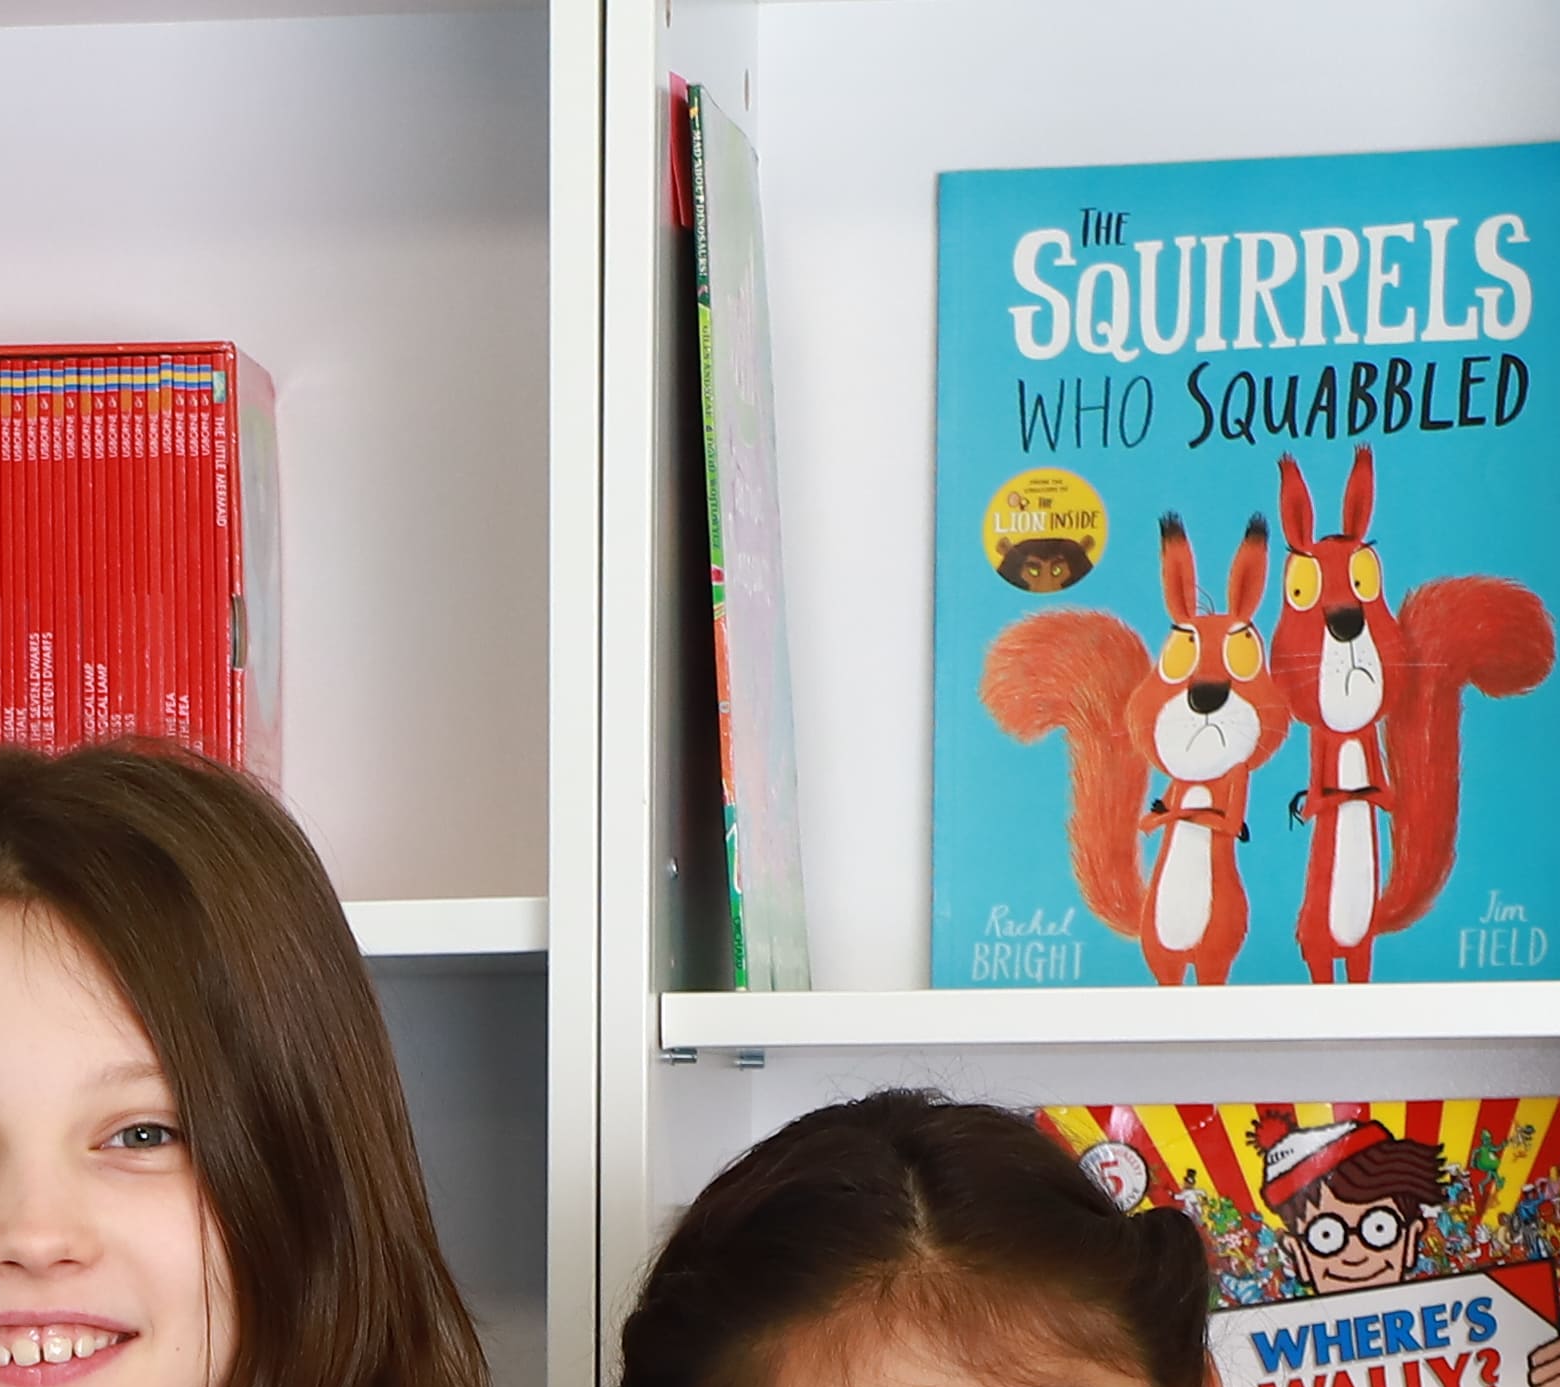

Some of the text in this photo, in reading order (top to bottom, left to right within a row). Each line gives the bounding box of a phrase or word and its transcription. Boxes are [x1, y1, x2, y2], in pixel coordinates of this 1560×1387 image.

[1081, 208, 1130, 247] THE
[1008, 213, 1532, 363] SQUIRRELS
[1017, 353, 1530, 453] WHO SQUABBLED
[993, 509, 1100, 533] LION INSIDE
[984, 904, 1073, 937] Rachel
[1479, 889, 1528, 925] Jim
[972, 941, 1084, 983] BRIGHT
[1458, 926, 1548, 969] FIELD
[1251, 1297, 1499, 1374] WHERE'S
